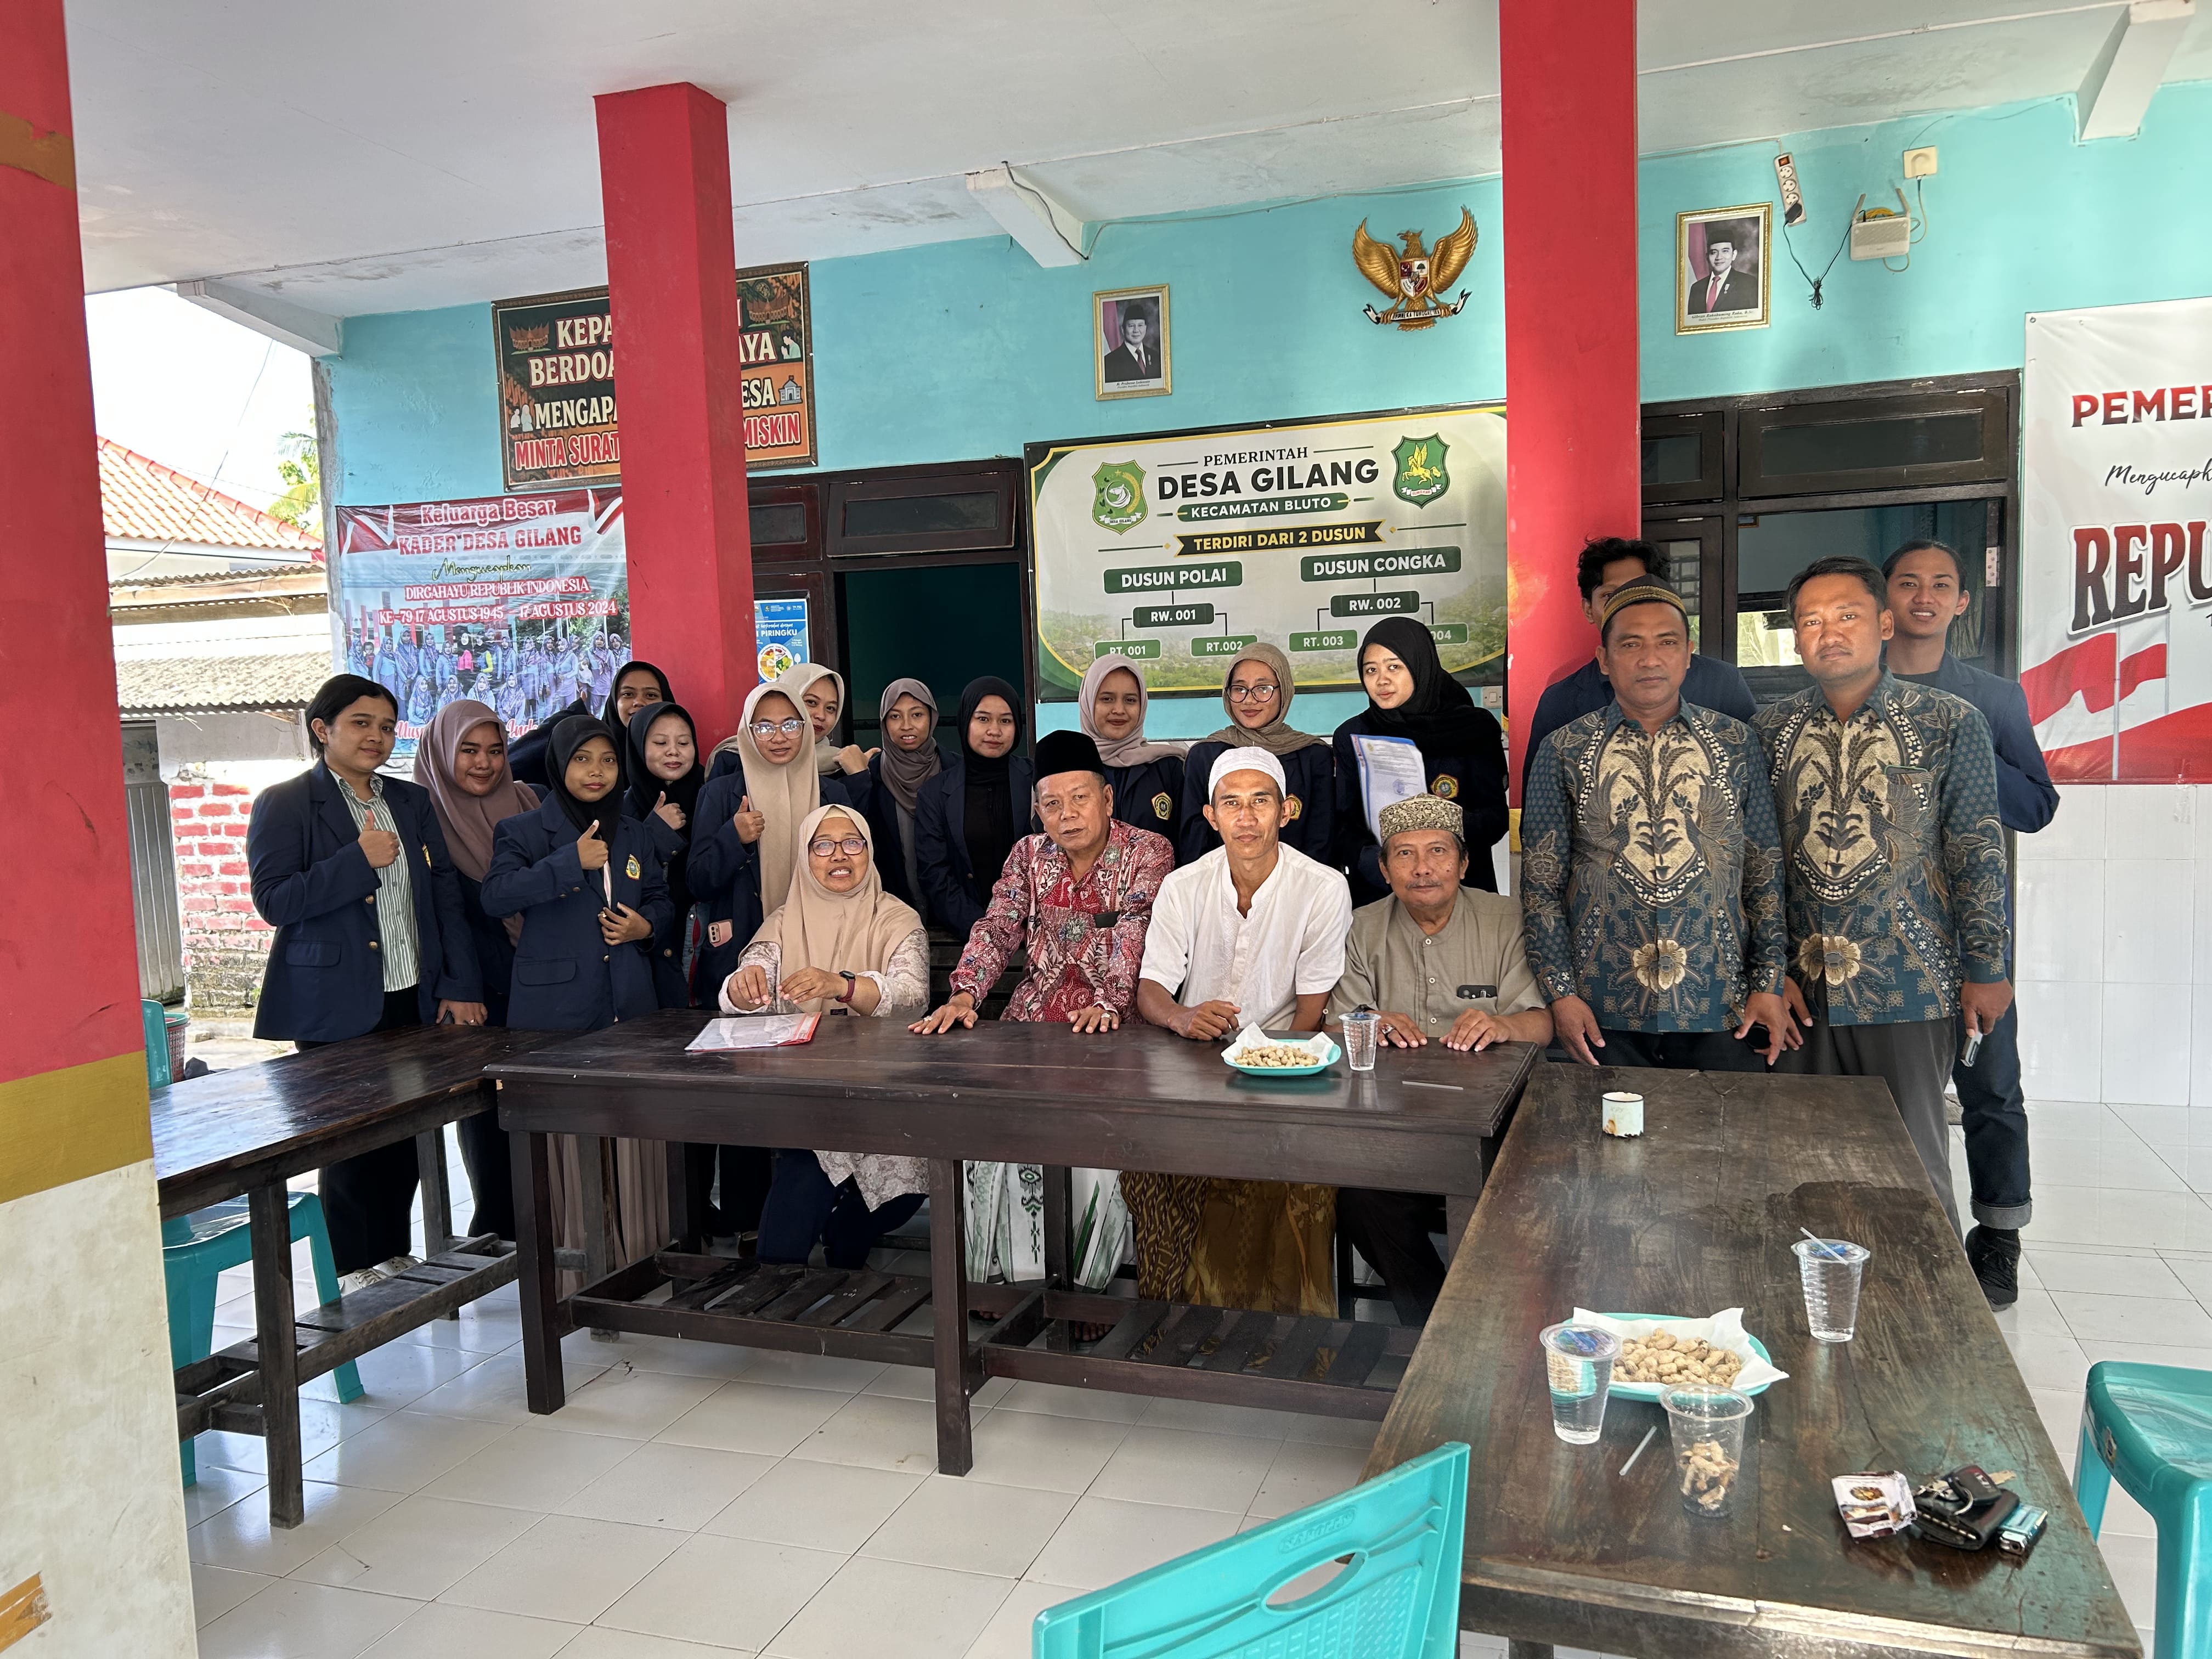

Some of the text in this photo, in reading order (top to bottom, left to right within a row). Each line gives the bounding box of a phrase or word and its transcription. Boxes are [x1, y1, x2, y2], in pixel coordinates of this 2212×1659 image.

[557, 315, 612, 348] KEPA
[742, 379, 776, 407] ESA
[535, 397, 618, 429] MENGAP
[516, 431, 620, 469] MINTA SURAT
[1203, 447, 1308, 467] PEMERINTAH
[1158, 459, 1379, 500] DESA GILANG
[421, 500, 555, 526] Keluarga Besar
[1191, 497, 1331, 518] KECAMATAN BLUTO
[399, 526, 582, 555] KADER DESA GILANG
[1194, 526, 1365, 551] TERDIRI DARI 2 DUSUN
[1313, 553, 1447, 576] DUSUN CONGKA
[405, 578, 589, 600] DIRGAHAYU REPUBLIK INDONESIA
[1121, 568, 1227, 588] DUSUN POLAI
[416, 610, 425, 622] 17
[427, 607, 477, 622] AGUSTUS
[520, 605, 529, 618] 17
[529, 602, 585, 617] AGUSTUS
[588, 600, 617, 615] 2024
[1349, 597, 1401, 611] RW. 002
[1150, 608, 1196, 623] RW. 001
[1127, 645, 1146, 656] 001
[1303, 635, 1344, 647] RT. 003
